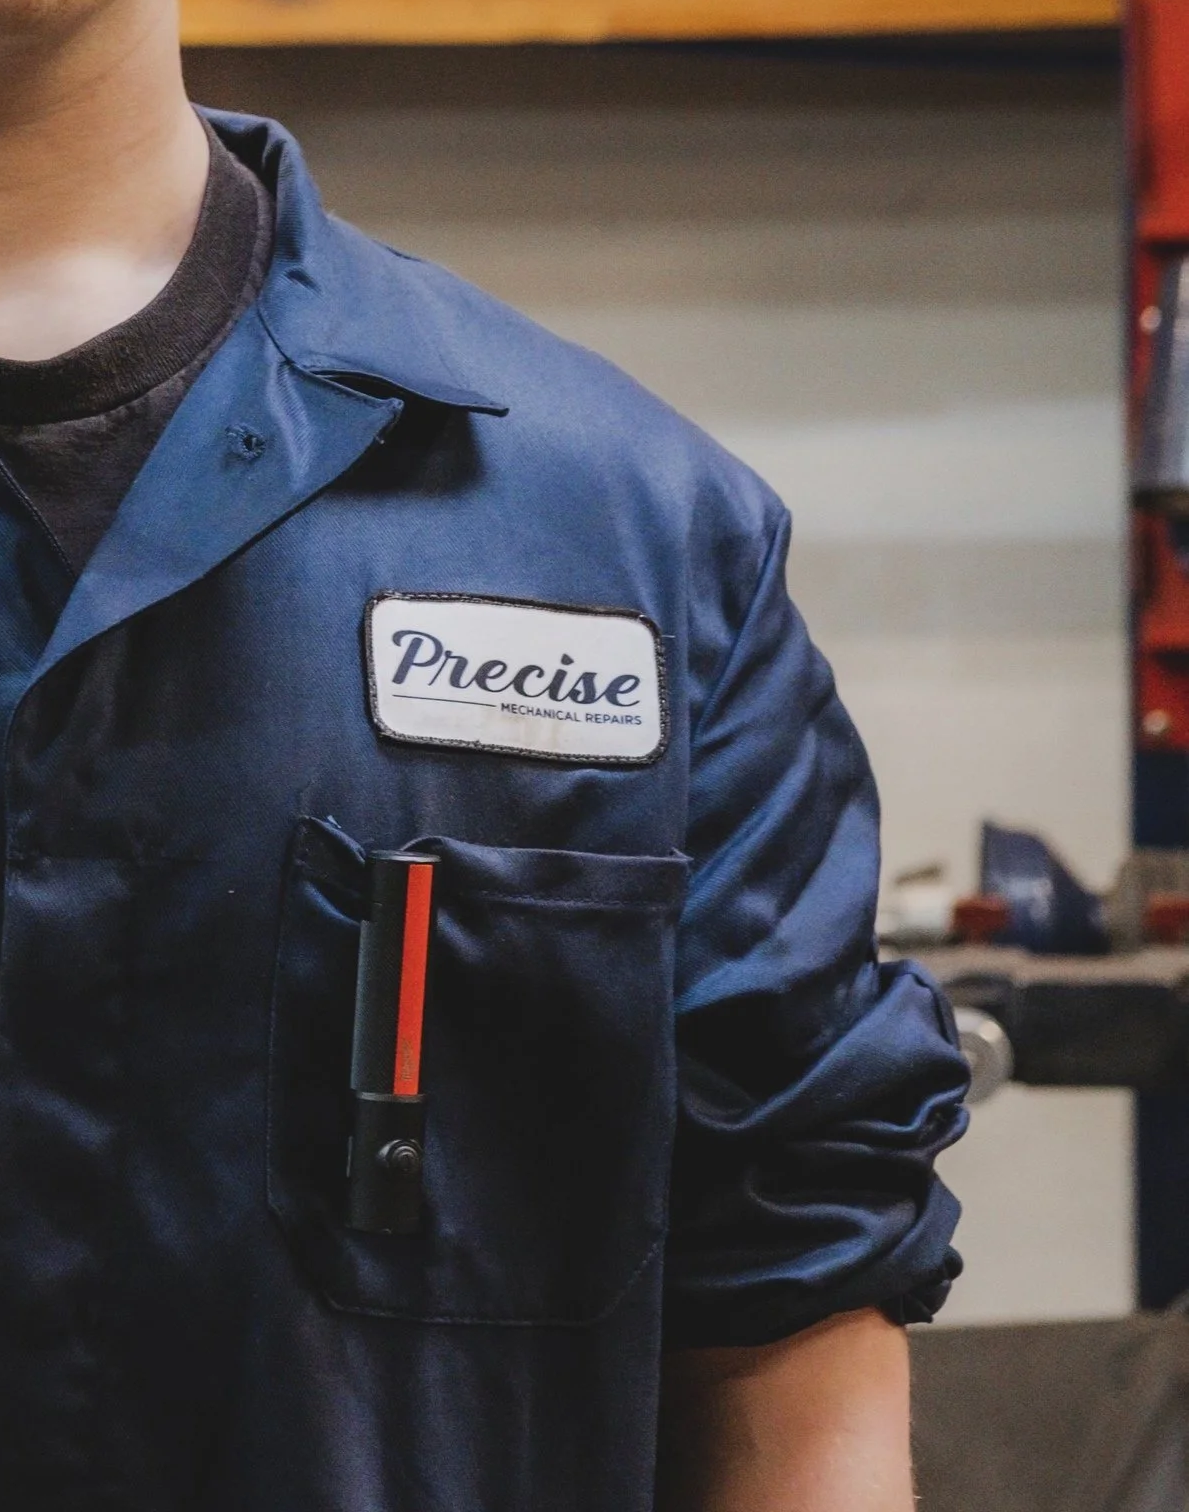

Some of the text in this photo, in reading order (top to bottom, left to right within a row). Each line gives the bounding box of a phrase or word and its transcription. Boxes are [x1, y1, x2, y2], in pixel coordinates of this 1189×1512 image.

[389, 629, 641, 707] Precise
[500, 702, 643, 726] MECHANICAL REPAIRS
